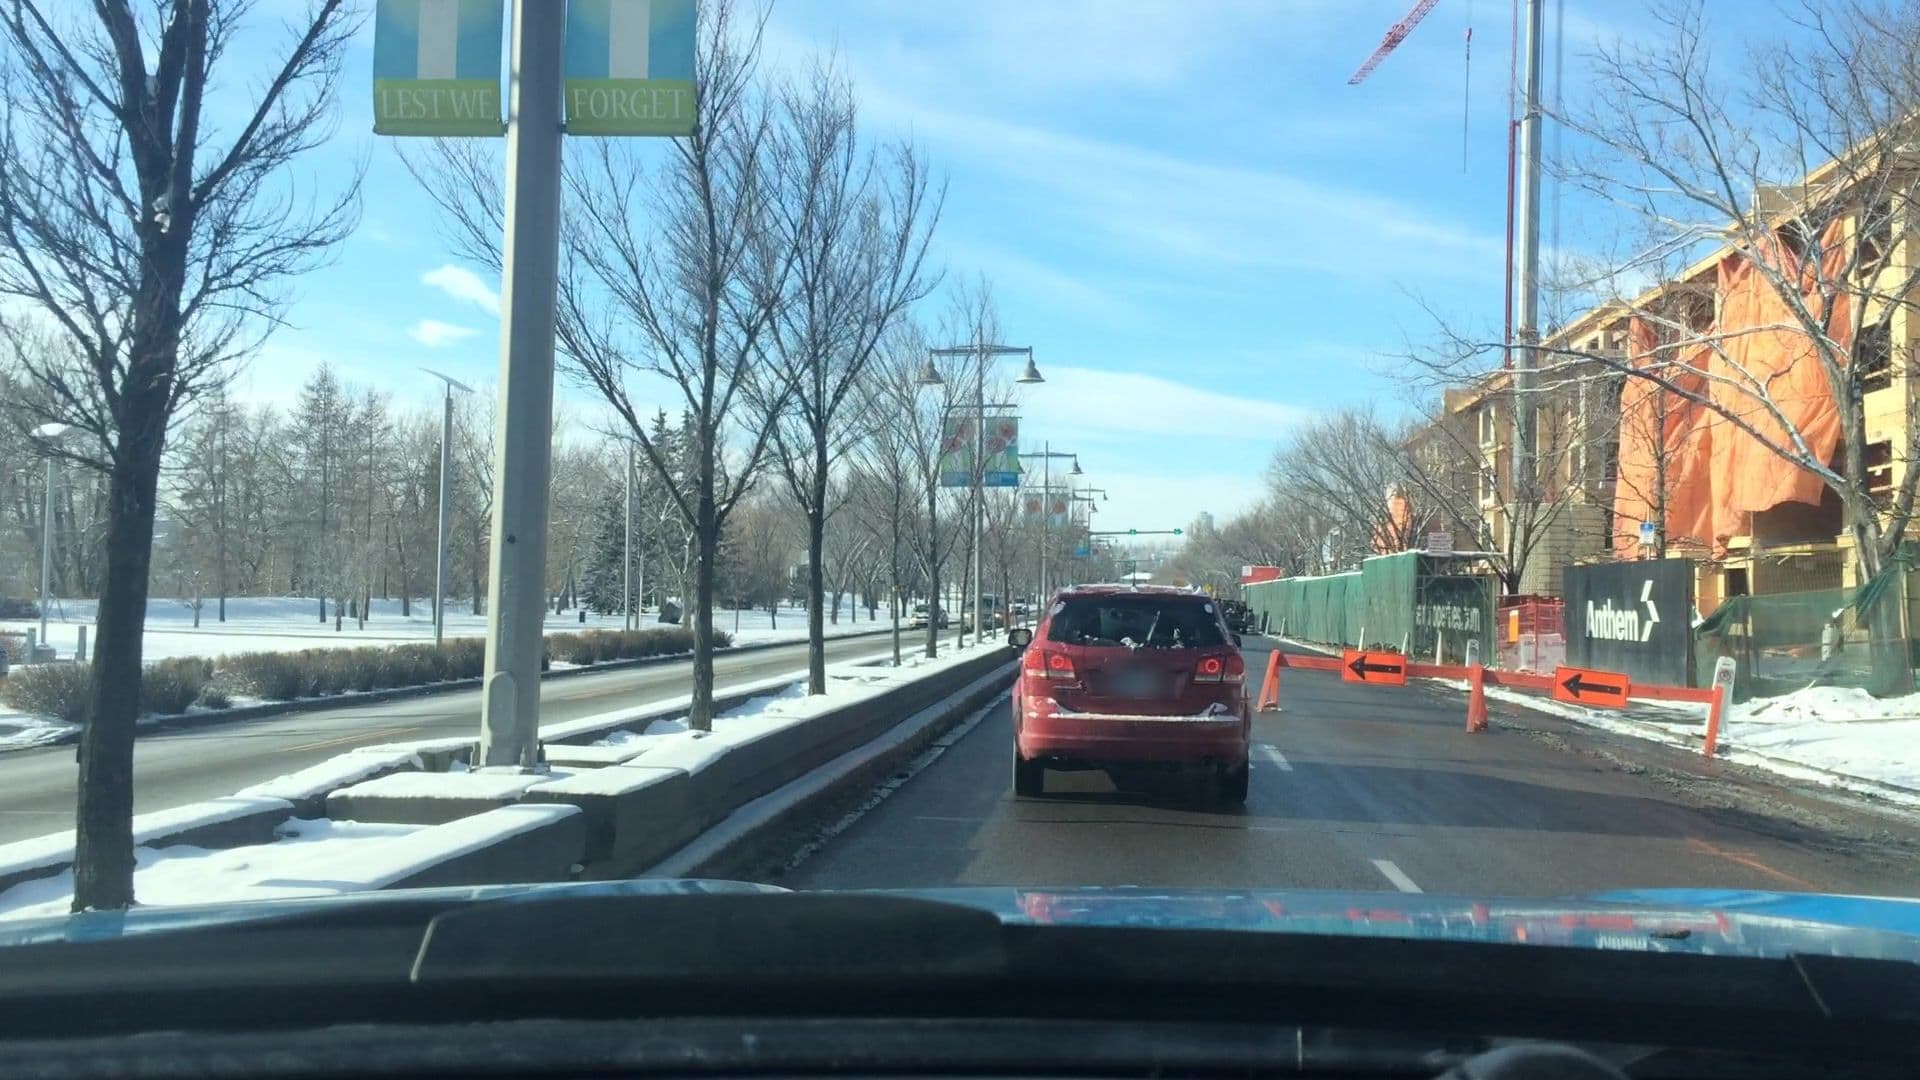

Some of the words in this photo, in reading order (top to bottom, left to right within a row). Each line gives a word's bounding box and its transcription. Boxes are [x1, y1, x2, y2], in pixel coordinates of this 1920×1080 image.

[382, 88, 445, 119] LEST
[447, 88, 494, 119] WE
[574, 87, 687, 119] FORGET
[1585, 598, 1639, 641] Anthem
